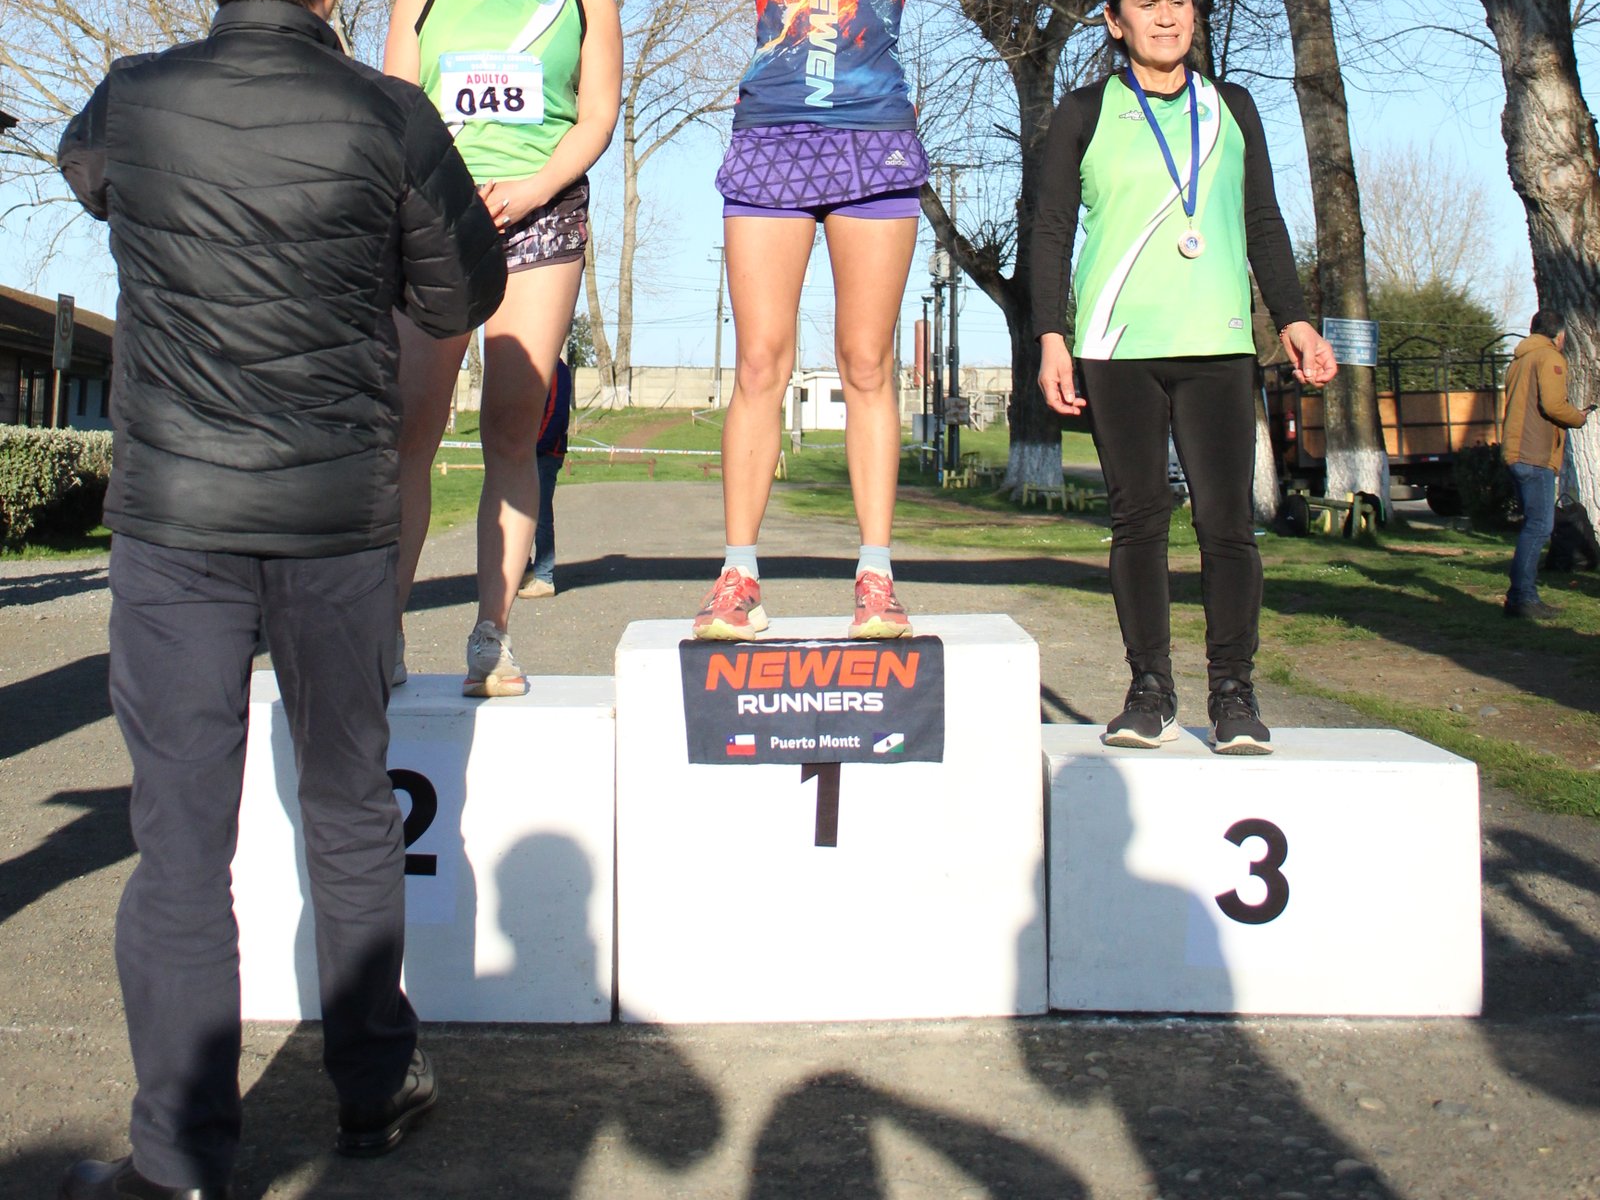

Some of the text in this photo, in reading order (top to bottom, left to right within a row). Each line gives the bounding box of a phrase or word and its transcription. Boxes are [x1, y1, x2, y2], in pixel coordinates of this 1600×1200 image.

[465, 73, 509, 86] ADULTO
[455, 86, 525, 116] 048
[705, 650, 920, 690] NEWEN
[737, 691, 884, 715] RUNNERS
[769, 734, 861, 749] Puerto Montt
[801, 762, 841, 848] 1
[1214, 817, 1290, 925] 3
